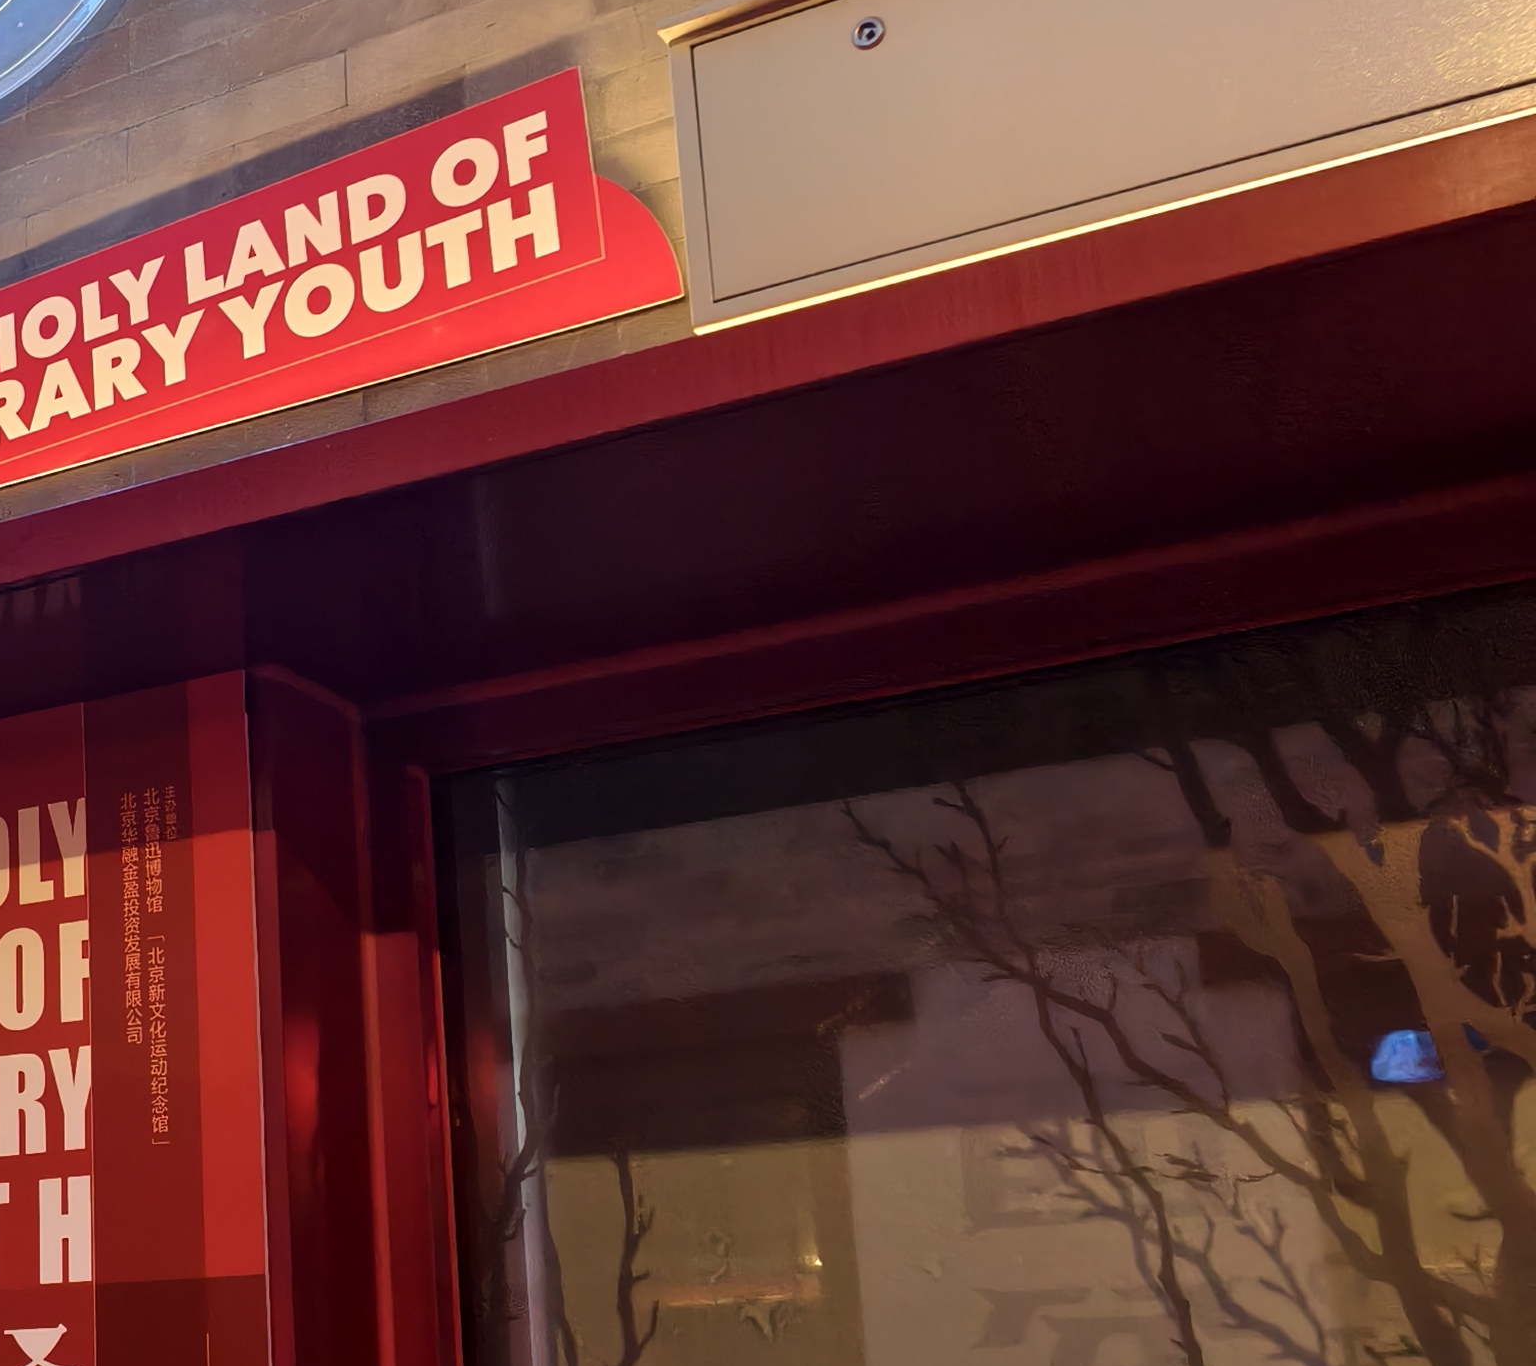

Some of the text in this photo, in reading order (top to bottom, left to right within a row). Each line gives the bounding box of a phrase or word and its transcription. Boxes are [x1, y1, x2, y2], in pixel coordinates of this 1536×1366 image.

[184, 174, 407, 305] LAND
[430, 110, 549, 209] OF
[219, 182, 561, 360] YOUTH
